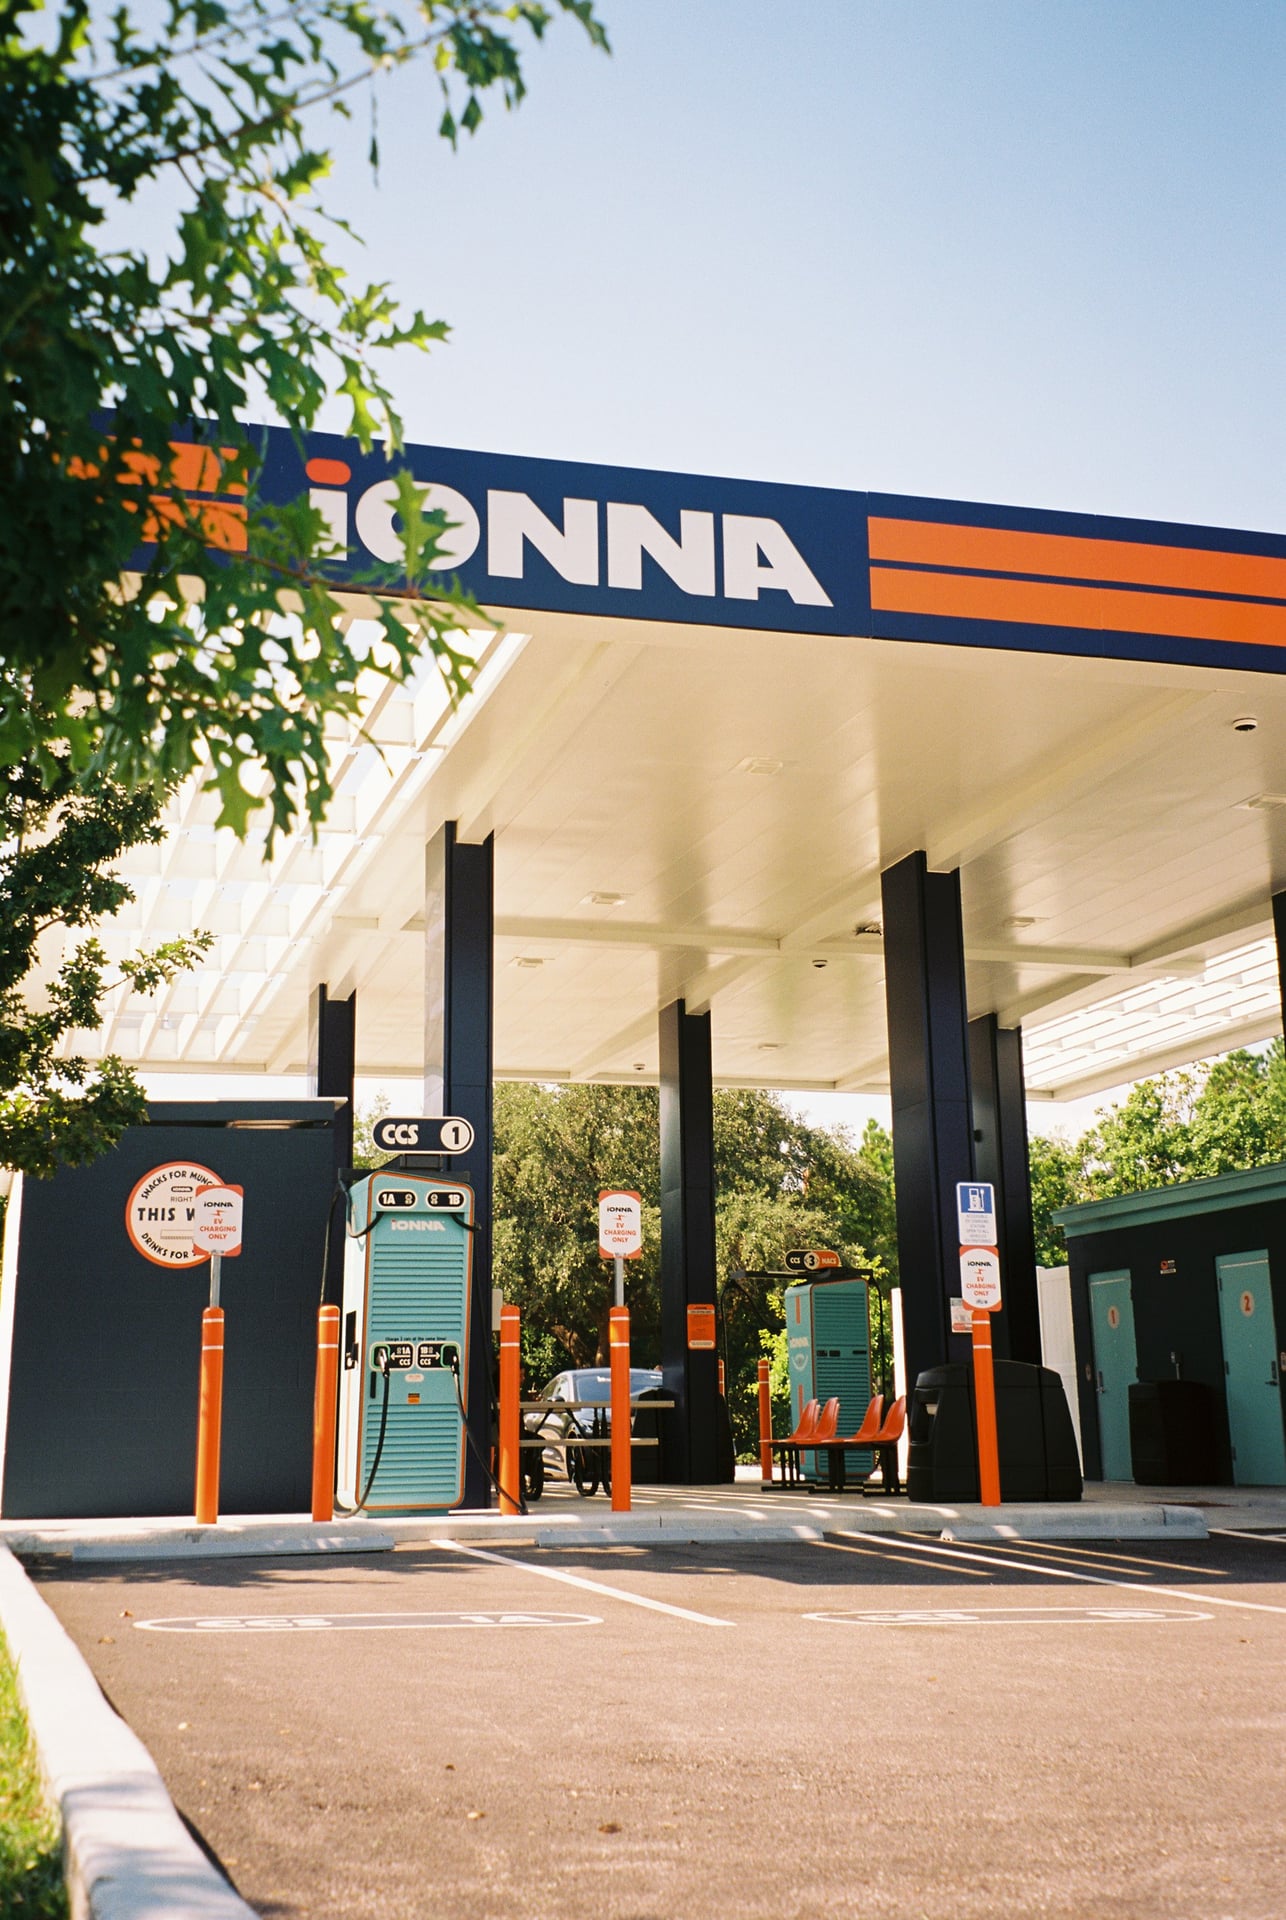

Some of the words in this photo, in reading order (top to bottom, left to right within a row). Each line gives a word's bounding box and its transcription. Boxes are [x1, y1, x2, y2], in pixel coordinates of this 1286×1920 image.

[381, 1123, 419, 1145] CCS
[451, 1126, 460, 1145] 1
[141, 1175, 168, 1200] SNACKS
[169, 1170, 187, 1180] FOR
[189, 1171, 214, 1186] MUNC
[382, 1193, 396, 1205] 1A
[448, 1194, 461, 1205] 1B
[137, 1207, 176, 1221] THIS
[141, 1232, 168, 1259] DRINKS
[169, 1251, 189, 1259] FOR
[808, 1255, 815, 1266] 3
[966, 1282, 997, 1290] CHARGING
[1243, 1295, 1251, 1312] 2
[399, 1358, 411, 1366] CCS
[420, 1358, 431, 1366] CCS
